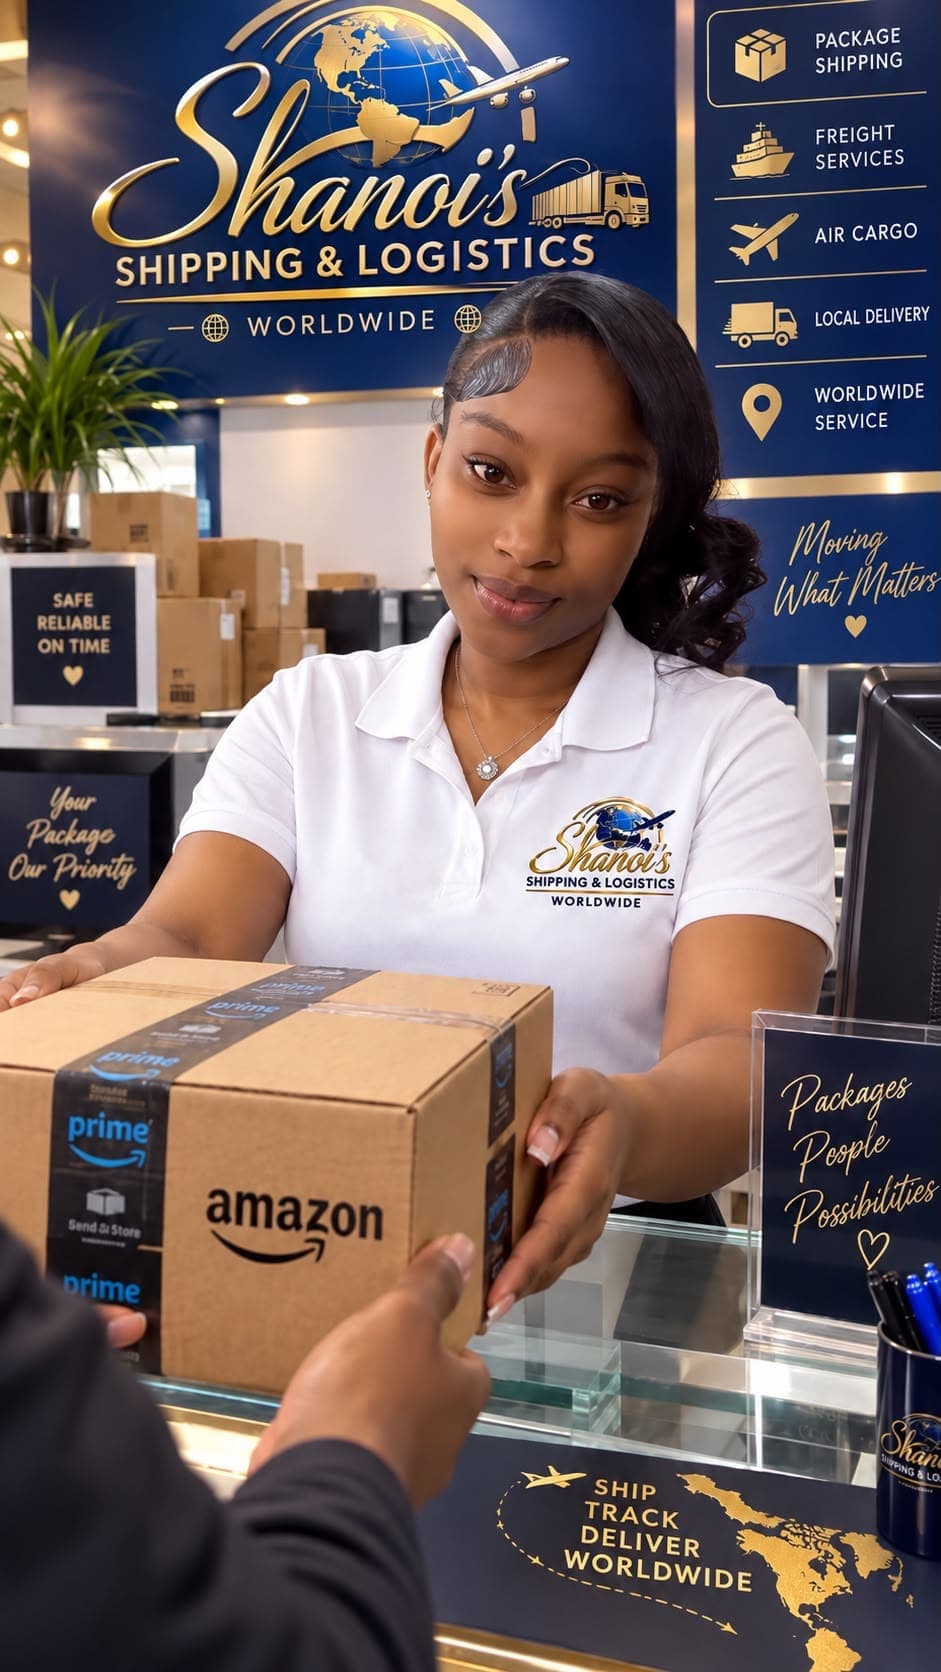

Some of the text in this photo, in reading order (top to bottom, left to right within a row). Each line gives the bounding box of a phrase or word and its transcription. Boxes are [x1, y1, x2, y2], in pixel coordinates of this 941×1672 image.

[815, 27, 901, 49] PACKAGE
[815, 52, 903, 74] SHIPPING
[815, 124, 896, 145] FREIGHT
[91, 61, 528, 249] Shanoi's
[815, 149, 905, 170] SERVICES
[815, 222, 918, 244] AIR CARGO
[115, 233, 595, 287] SHIPPING & LOGISTICS
[247, 309, 436, 338] WORLDWIDE
[815, 306, 930, 327] LOCAL DELIVERY
[814, 383, 925, 403] WORLDWIDE
[815, 412, 888, 430] SERVICE
[788, 520, 889, 566] Moving
[53, 592, 94, 609] SAFE
[773, 561, 941, 616] What Matters
[37, 614, 111, 632] RELIABLE
[37, 637, 111, 655] ON TIME
[49, 786, 96, 821] Your
[26, 819, 116, 855] Package
[528, 820, 673, 875] Shanoi's
[8, 852, 137, 890] Our Priority
[526, 876, 675, 890] SHIPPING & LOGISTICS
[551, 896, 641, 908] WORLDWIDE
[96, 1050, 181, 1067] prime
[781, 1073, 913, 1131] Packages
[67, 1111, 150, 1144] prime
[793, 1120, 891, 1184] People
[206, 1188, 384, 1241] amazon
[784, 1174, 940, 1244] Possibilities
[68, 1219, 98, 1233] Send
[111, 1225, 142, 1239] Store
[594, 1479, 656, 1501] SHIP
[584, 1501, 679, 1530] TRACK
[581, 1525, 700, 1558] DELIVER
[564, 1549, 753, 1592] WORLDWIDE
